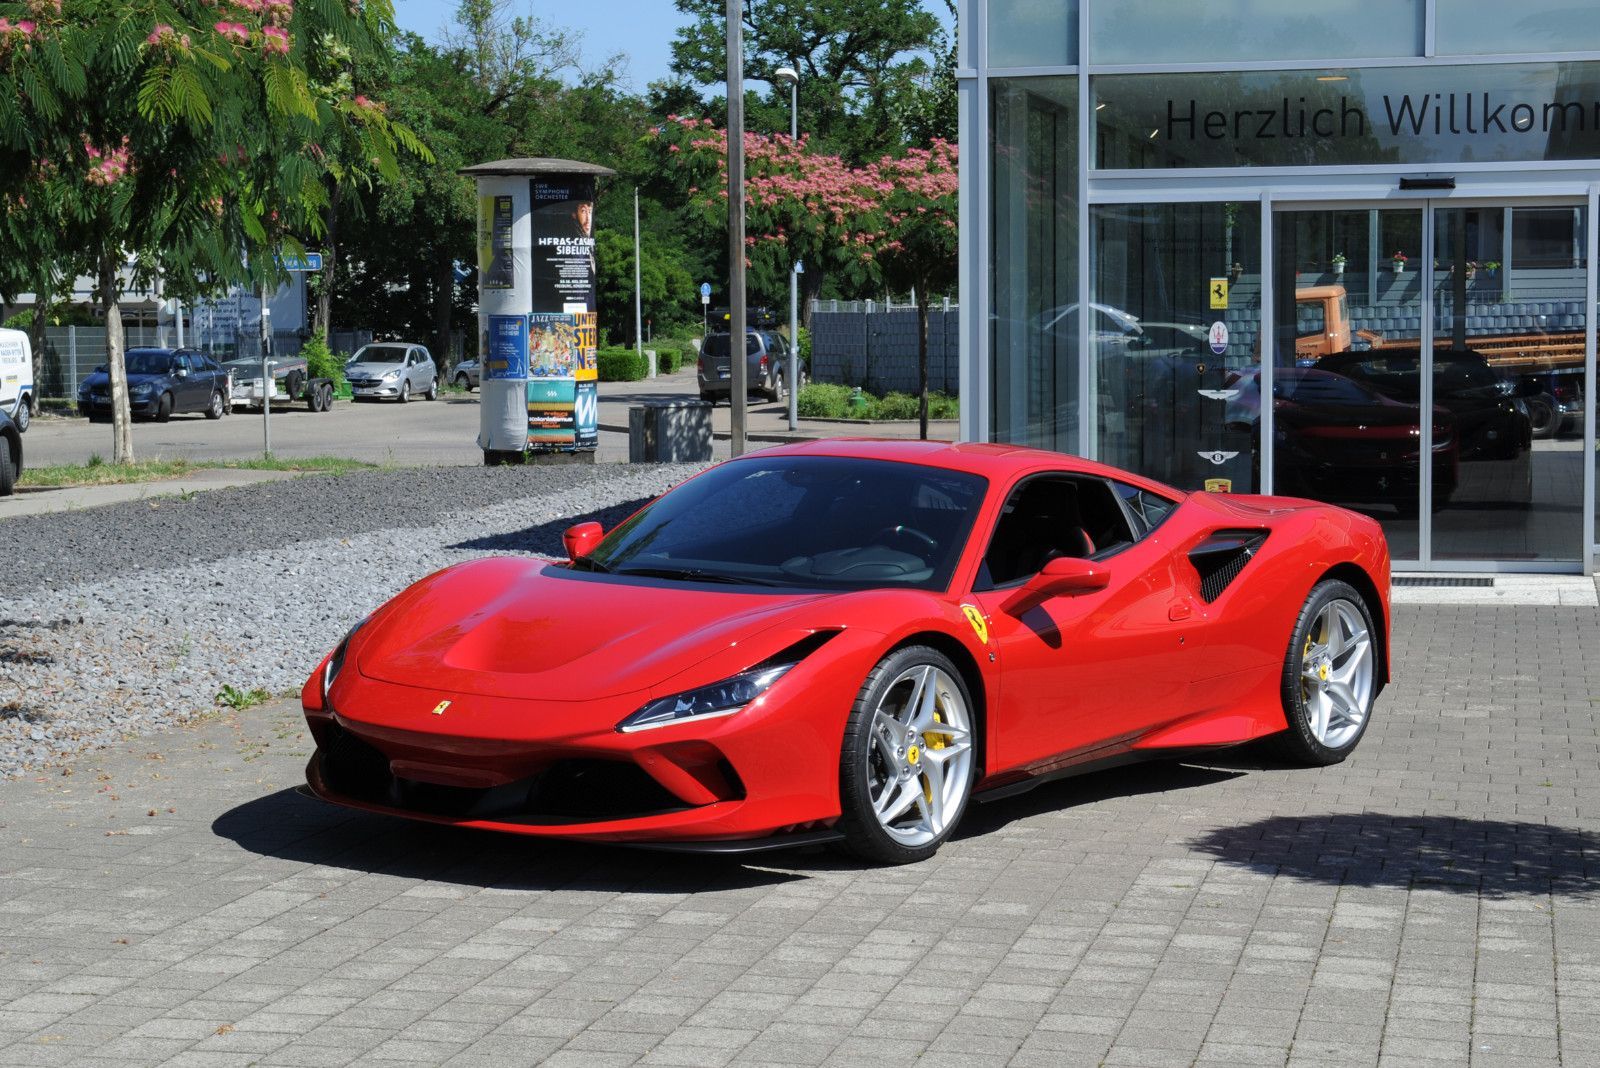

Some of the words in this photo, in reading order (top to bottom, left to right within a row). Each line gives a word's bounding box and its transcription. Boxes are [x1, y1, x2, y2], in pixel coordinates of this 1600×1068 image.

[1167, 96, 1364, 140] Herzlich
[1383, 92, 1600, 136] Willkom
[556, 246, 590, 255] SIBELIUS
[531, 315, 549, 323] JAZZ
